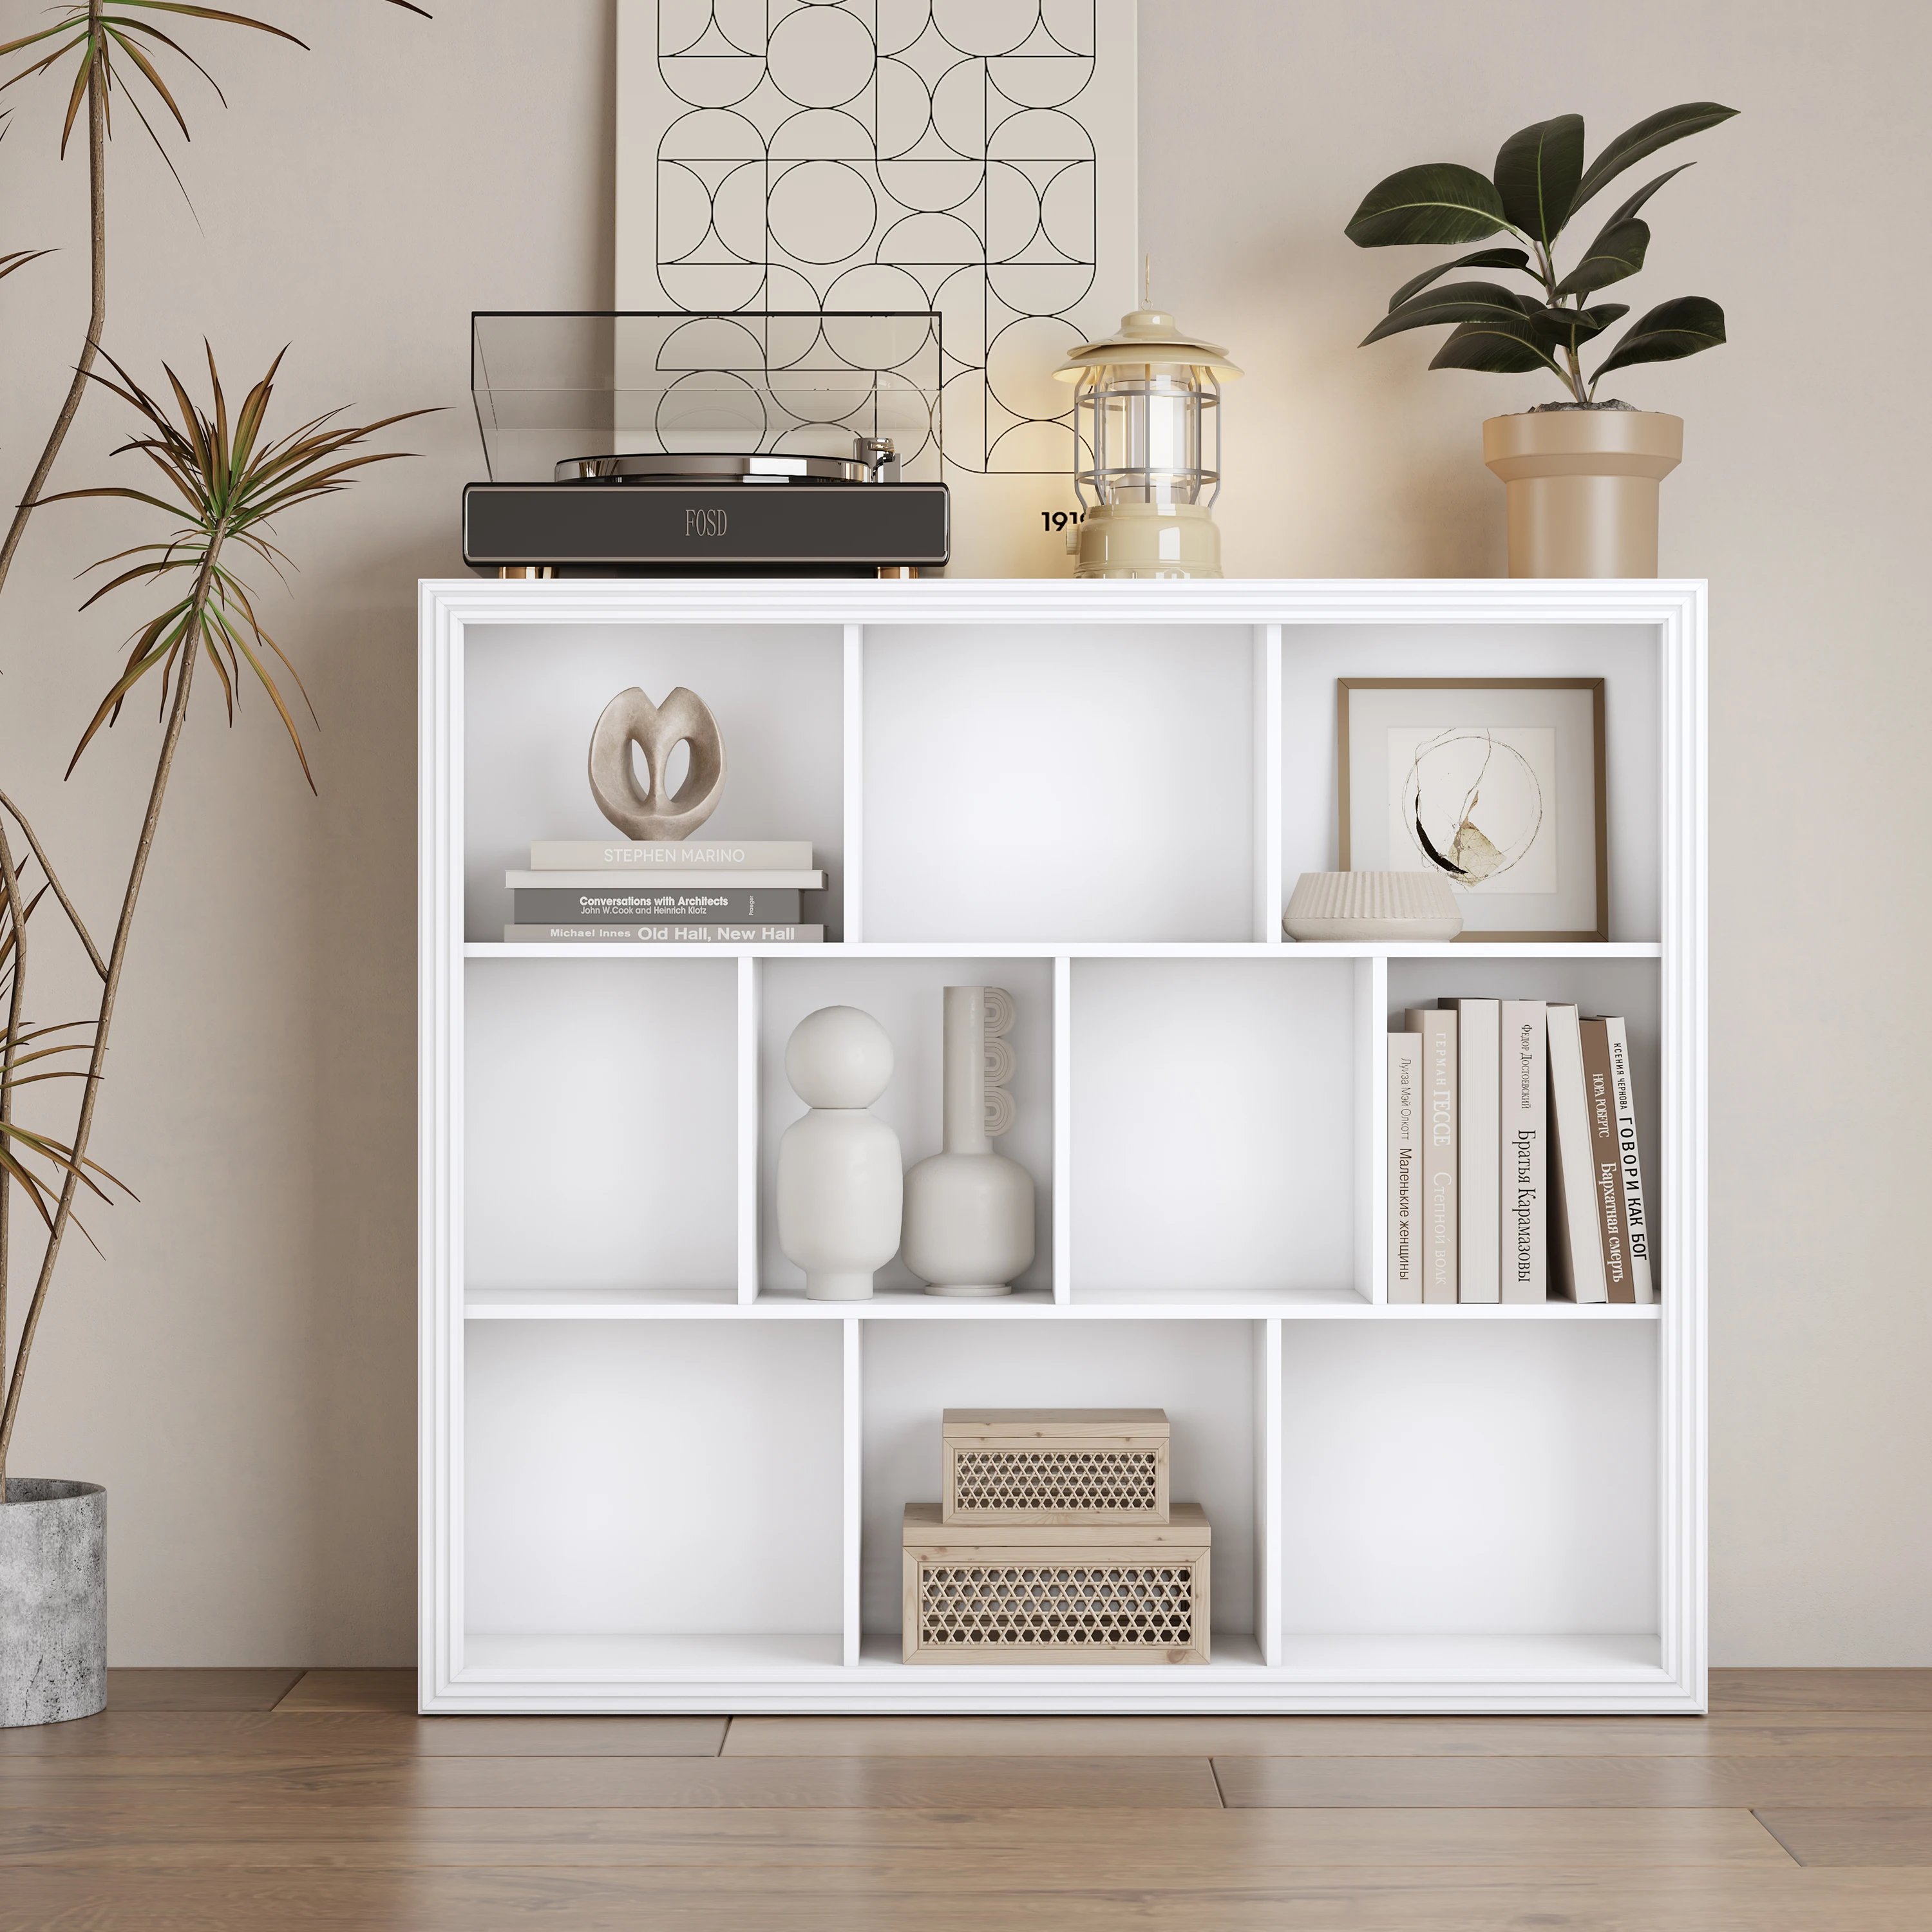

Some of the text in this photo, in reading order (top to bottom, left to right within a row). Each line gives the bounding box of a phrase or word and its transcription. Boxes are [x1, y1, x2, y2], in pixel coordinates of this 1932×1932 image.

[685, 509, 727, 536] FOSD
[604, 849, 745, 862] STEPHEN MARINO
[579, 896, 728, 907] Conversations with Architects
[580, 906, 600, 915] John
[635, 906, 652, 915] and
[654, 906, 686, 915] Heinrich
[688, 906, 706, 915] Klotz
[550, 927, 795, 942] Michael Innes Old Hall, New Hall
[1435, 1032, 1446, 1086] ГЕРМАН
[1433, 1090, 1451, 1147] ГЕССЕ
[1397, 1057, 1412, 1280] Луиза Мэй Олкотт Маленькие женщины
[1512, 1130, 1536, 1184] Братья
[1592, 1073, 1624, 1283] НОРА РОБЕРТС Бархатная смерть
[1613, 1043, 1647, 1261] КСЕНИЯ ЧЕРНОВА ГОВОРИ КАК БОГ
[1512, 1188, 1537, 1283] Карамазовы
[1435, 1249, 1446, 1285] волк
